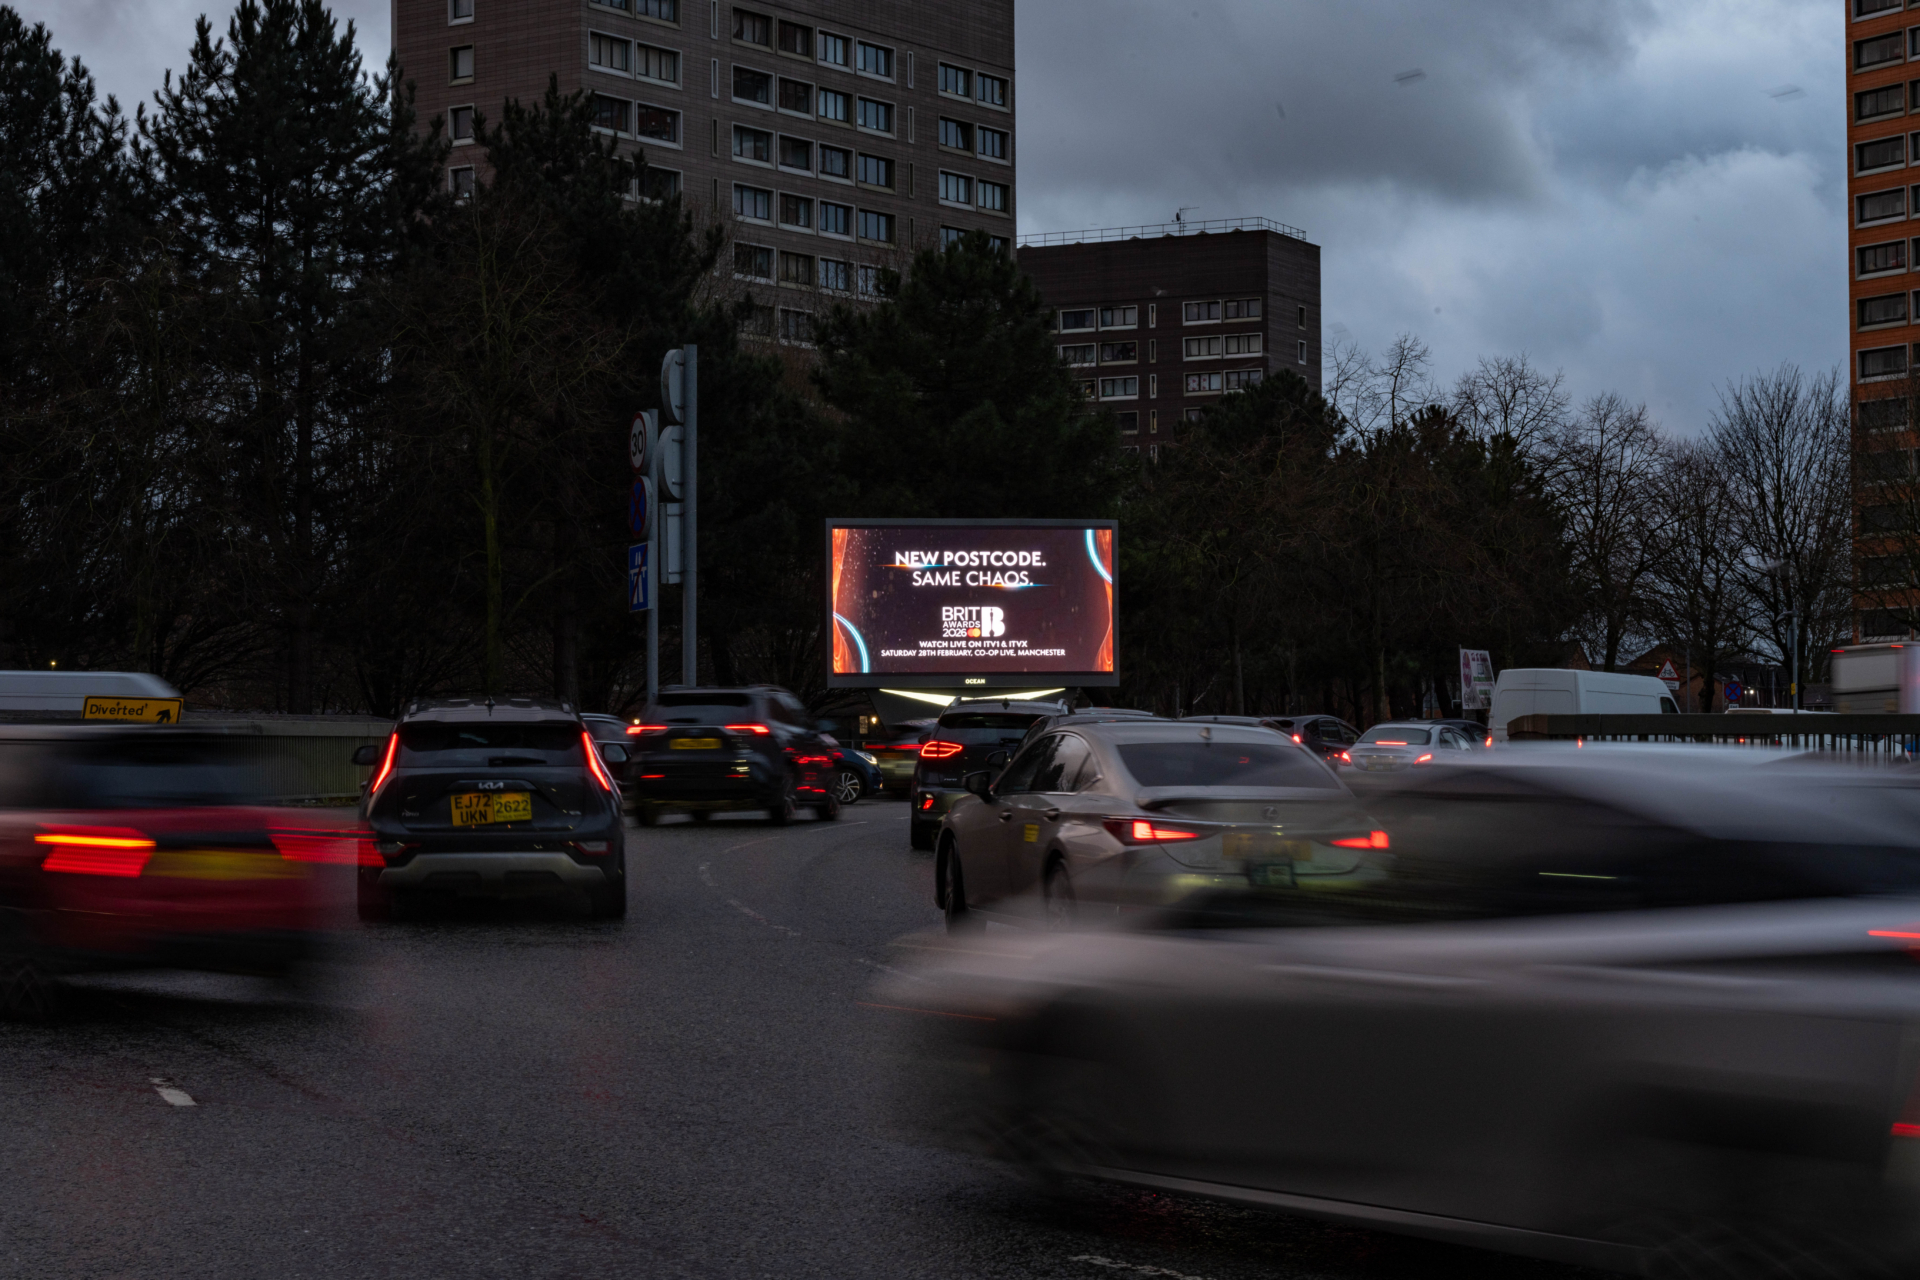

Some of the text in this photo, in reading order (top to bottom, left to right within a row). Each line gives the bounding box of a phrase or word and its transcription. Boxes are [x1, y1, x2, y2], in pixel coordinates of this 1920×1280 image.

[632, 430, 644, 457] 30
[895, 551, 1046, 567] NEW POSTCODE.
[913, 571, 1033, 587] SAME CHAOS.
[942, 607, 981, 621] BRIT
[942, 621, 981, 629] AWARDS
[943, 629, 967, 638] 2026
[881, 649, 917, 657] SATURDAY
[918, 649, 936, 657] 28TH
[937, 649, 973, 657] FEBRUARY,
[1000, 649, 1016, 657] LIVE,
[90, 704, 144, 715] Diverted
[455, 794, 491, 809] EJ72
[496, 800, 529, 813] 2622
[461, 810, 487, 823] UKN
